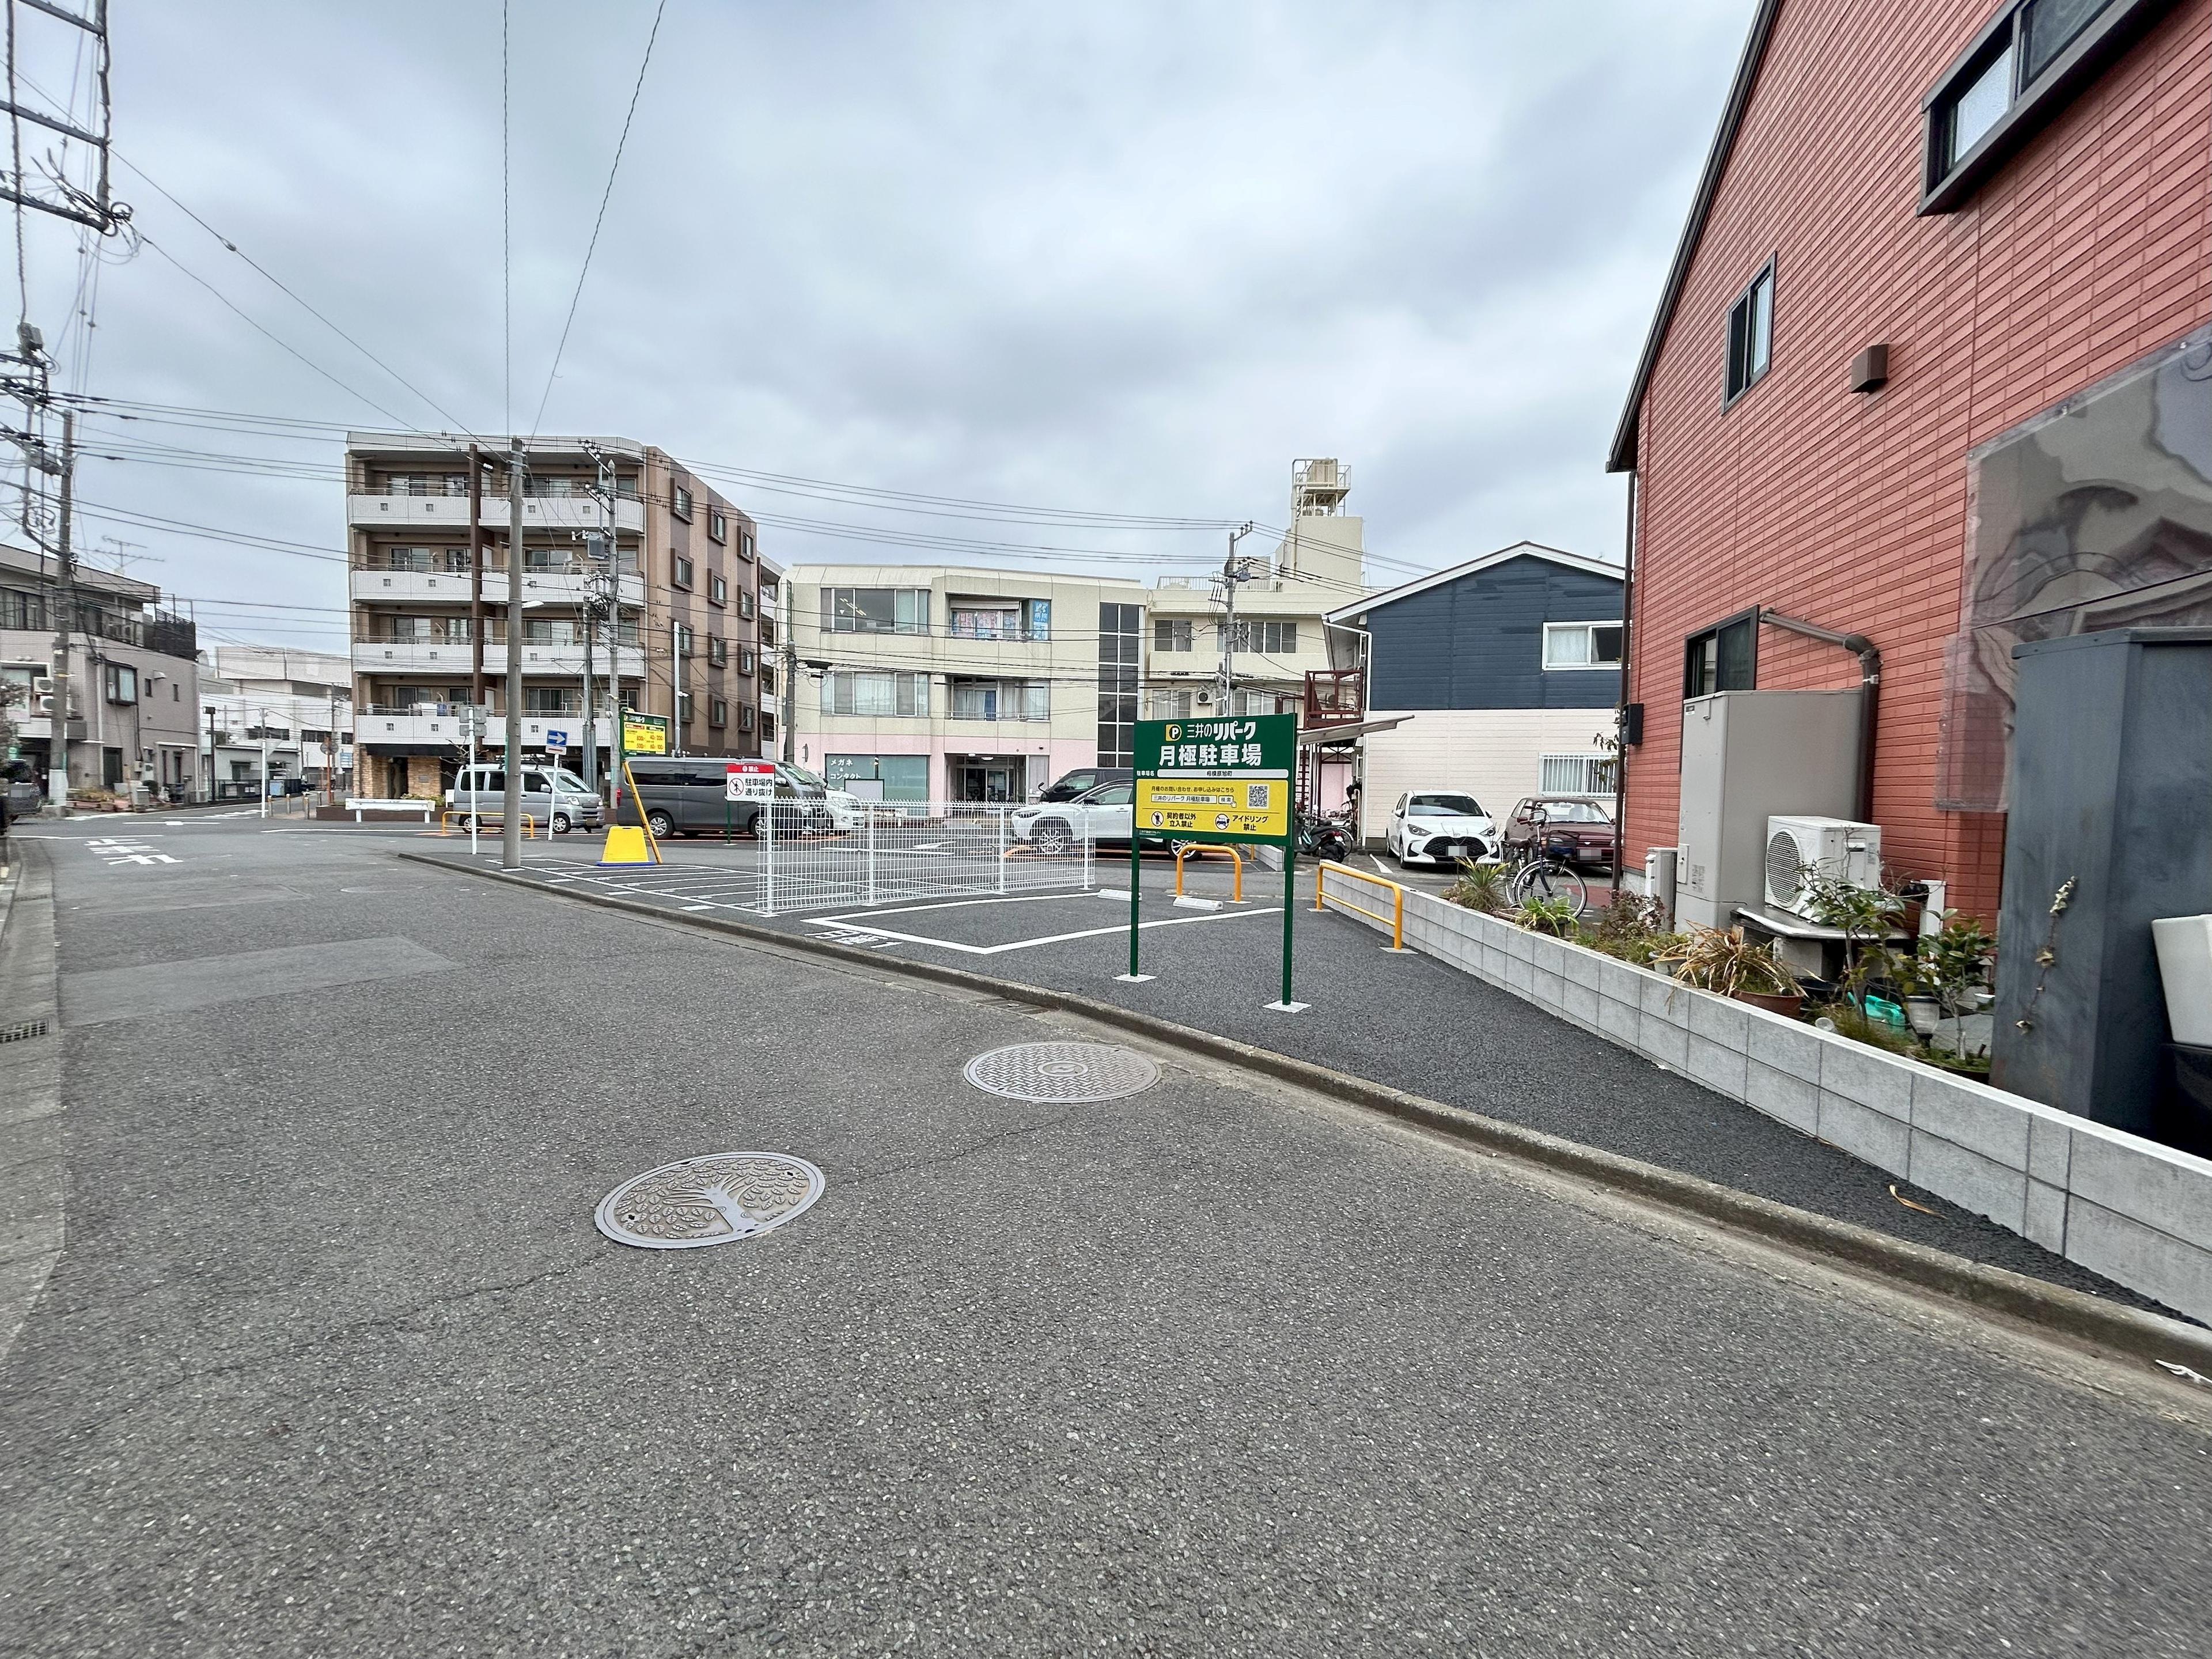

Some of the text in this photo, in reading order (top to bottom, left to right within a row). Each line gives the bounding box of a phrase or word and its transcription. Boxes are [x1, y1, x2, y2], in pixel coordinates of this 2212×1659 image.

[1187, 721, 1256, 741] 三井のリパーク
[1159, 743, 1262, 766] 月極駐車場
[745, 778, 772, 786] 駐車場内
[745, 788, 772, 796] 通り抜け
[1232, 815, 1268, 823] アイドリング
[1243, 823, 1257, 831] 禁止
